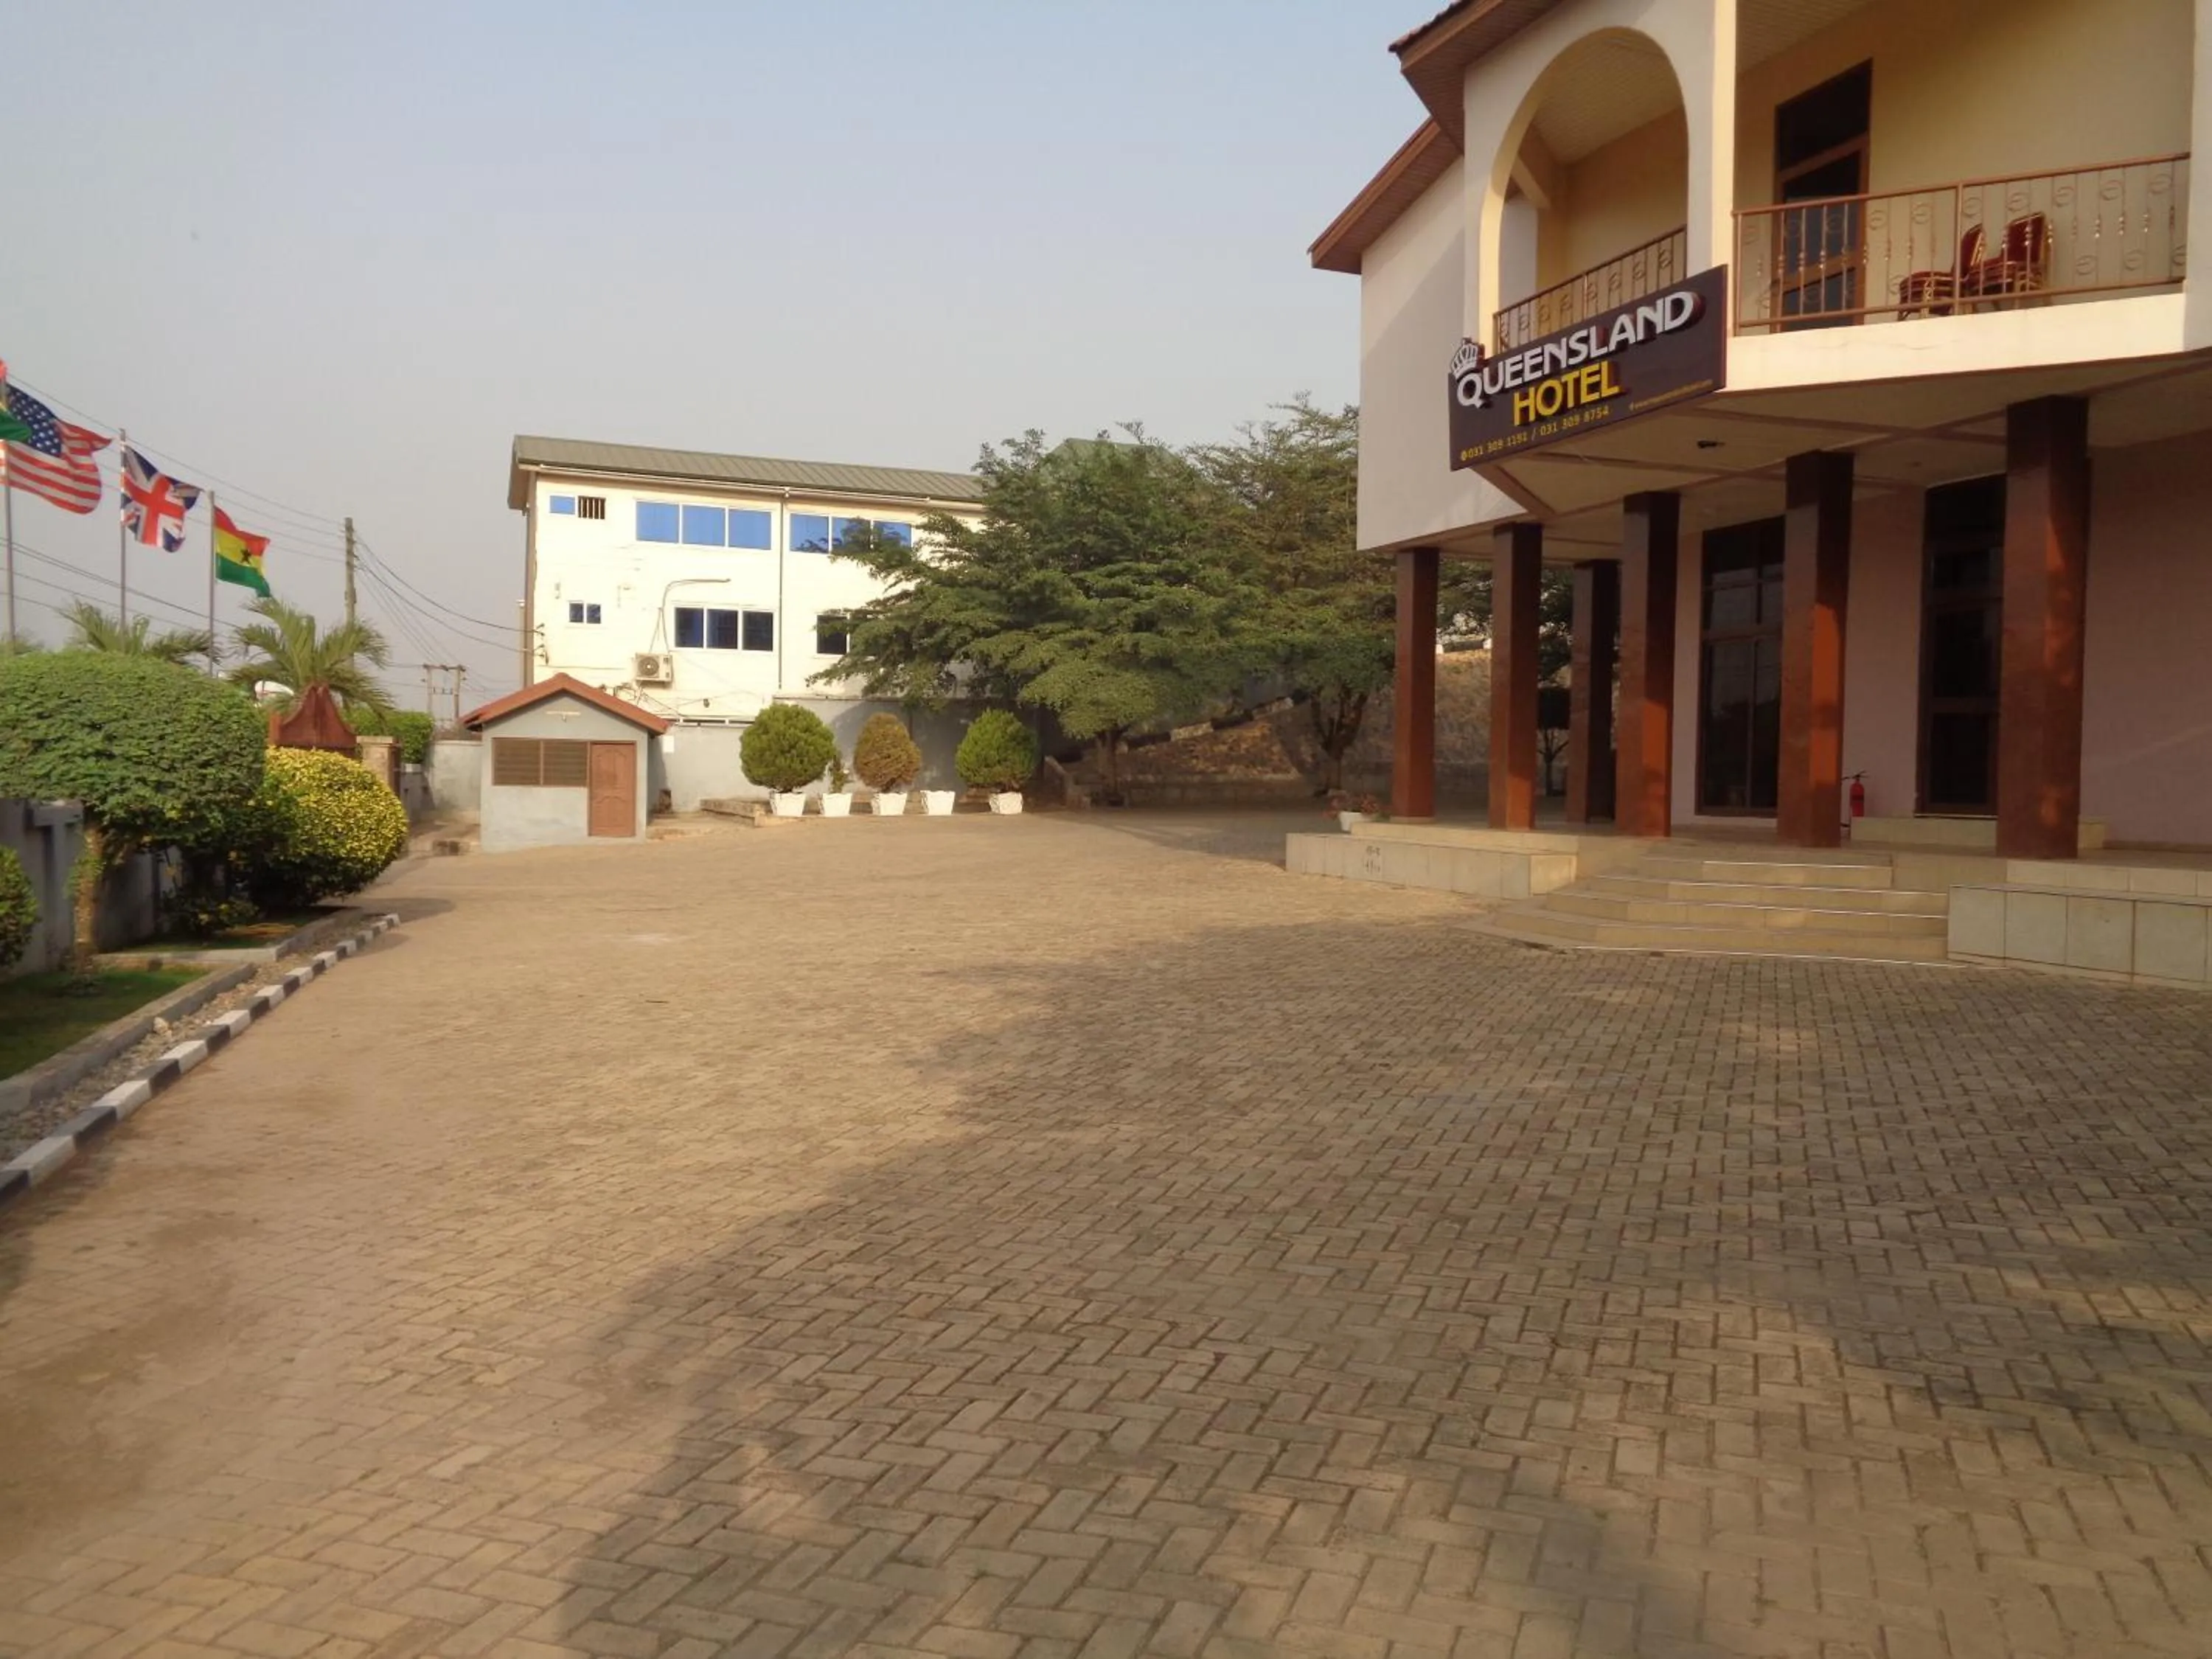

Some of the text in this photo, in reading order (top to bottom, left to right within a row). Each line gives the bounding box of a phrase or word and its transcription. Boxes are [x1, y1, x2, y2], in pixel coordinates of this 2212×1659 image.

[1457, 292, 1695, 408] QUEENSLAND
[1514, 361, 1619, 425] HOTEL
[1540, 422, 1557, 436] 031
